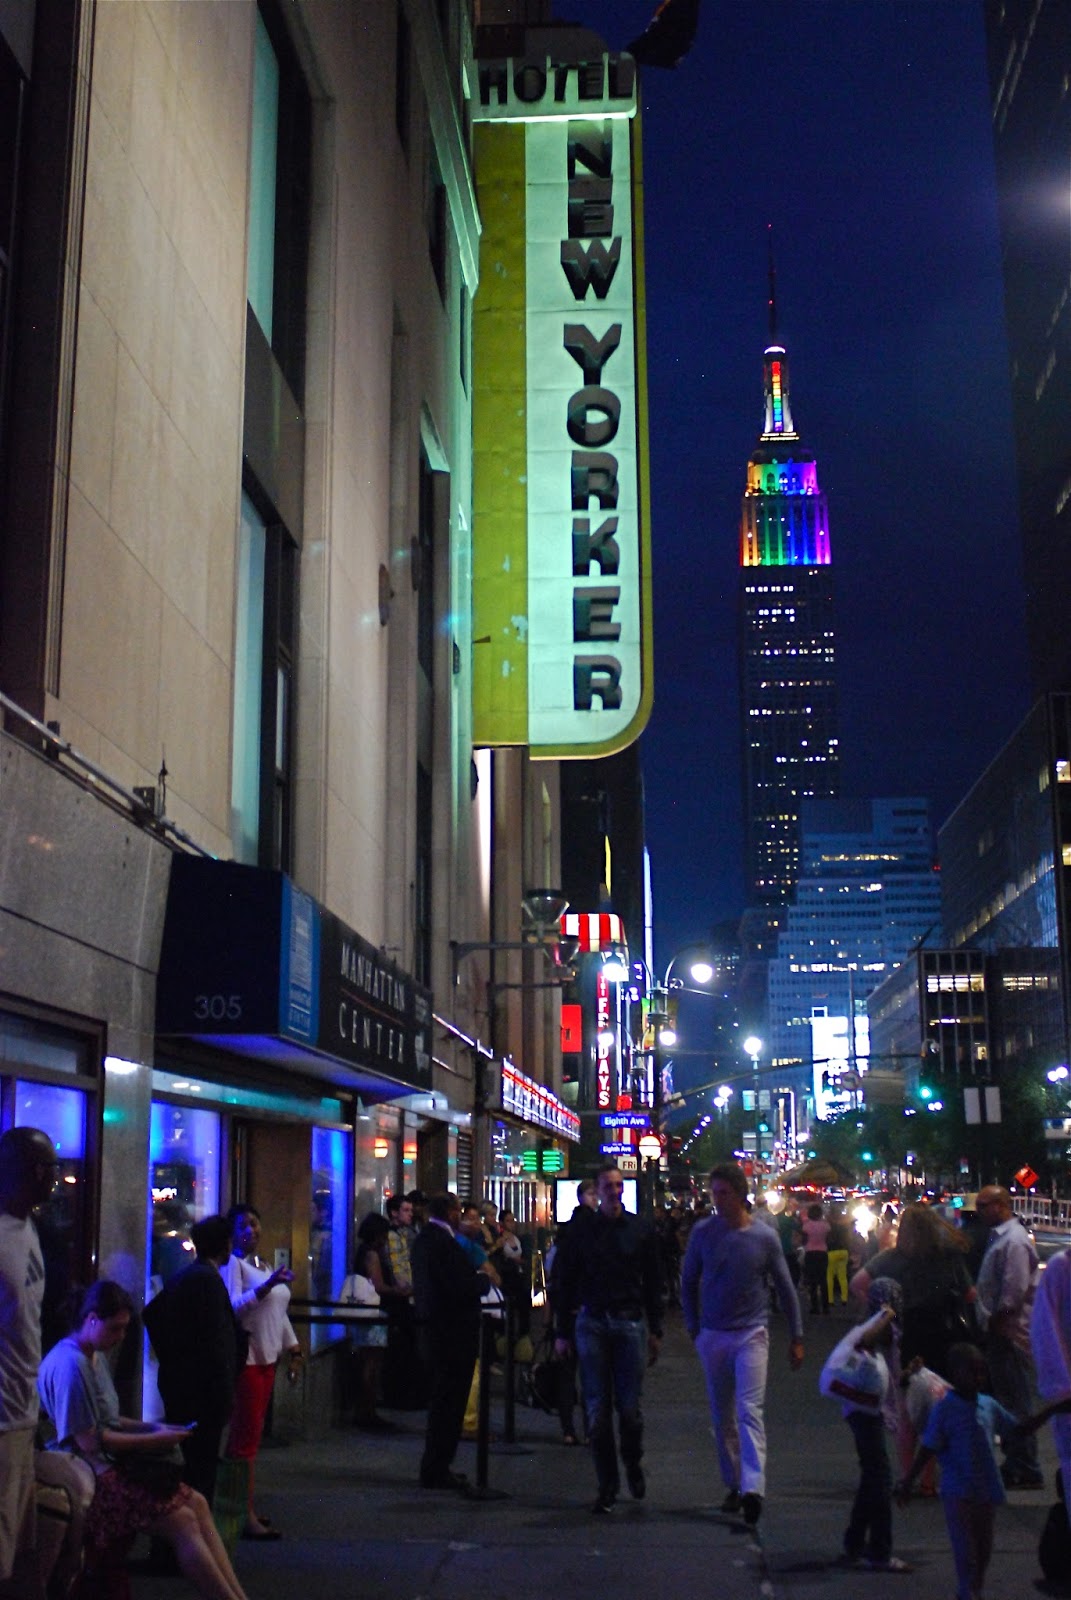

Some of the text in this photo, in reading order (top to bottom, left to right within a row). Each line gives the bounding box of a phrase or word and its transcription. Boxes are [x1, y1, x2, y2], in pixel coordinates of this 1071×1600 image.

[479, 57, 634, 105] HOTEL
[561, 120, 623, 710] NEW YORKER
[194, 995, 242, 1019] 305
[340, 941, 405, 1012] MANHATTAN
[339, 1003, 404, 1064] CENTER
[598, 998, 610, 1106] FRDAY'S
[604, 1116, 645, 1126] Eighth Ave
